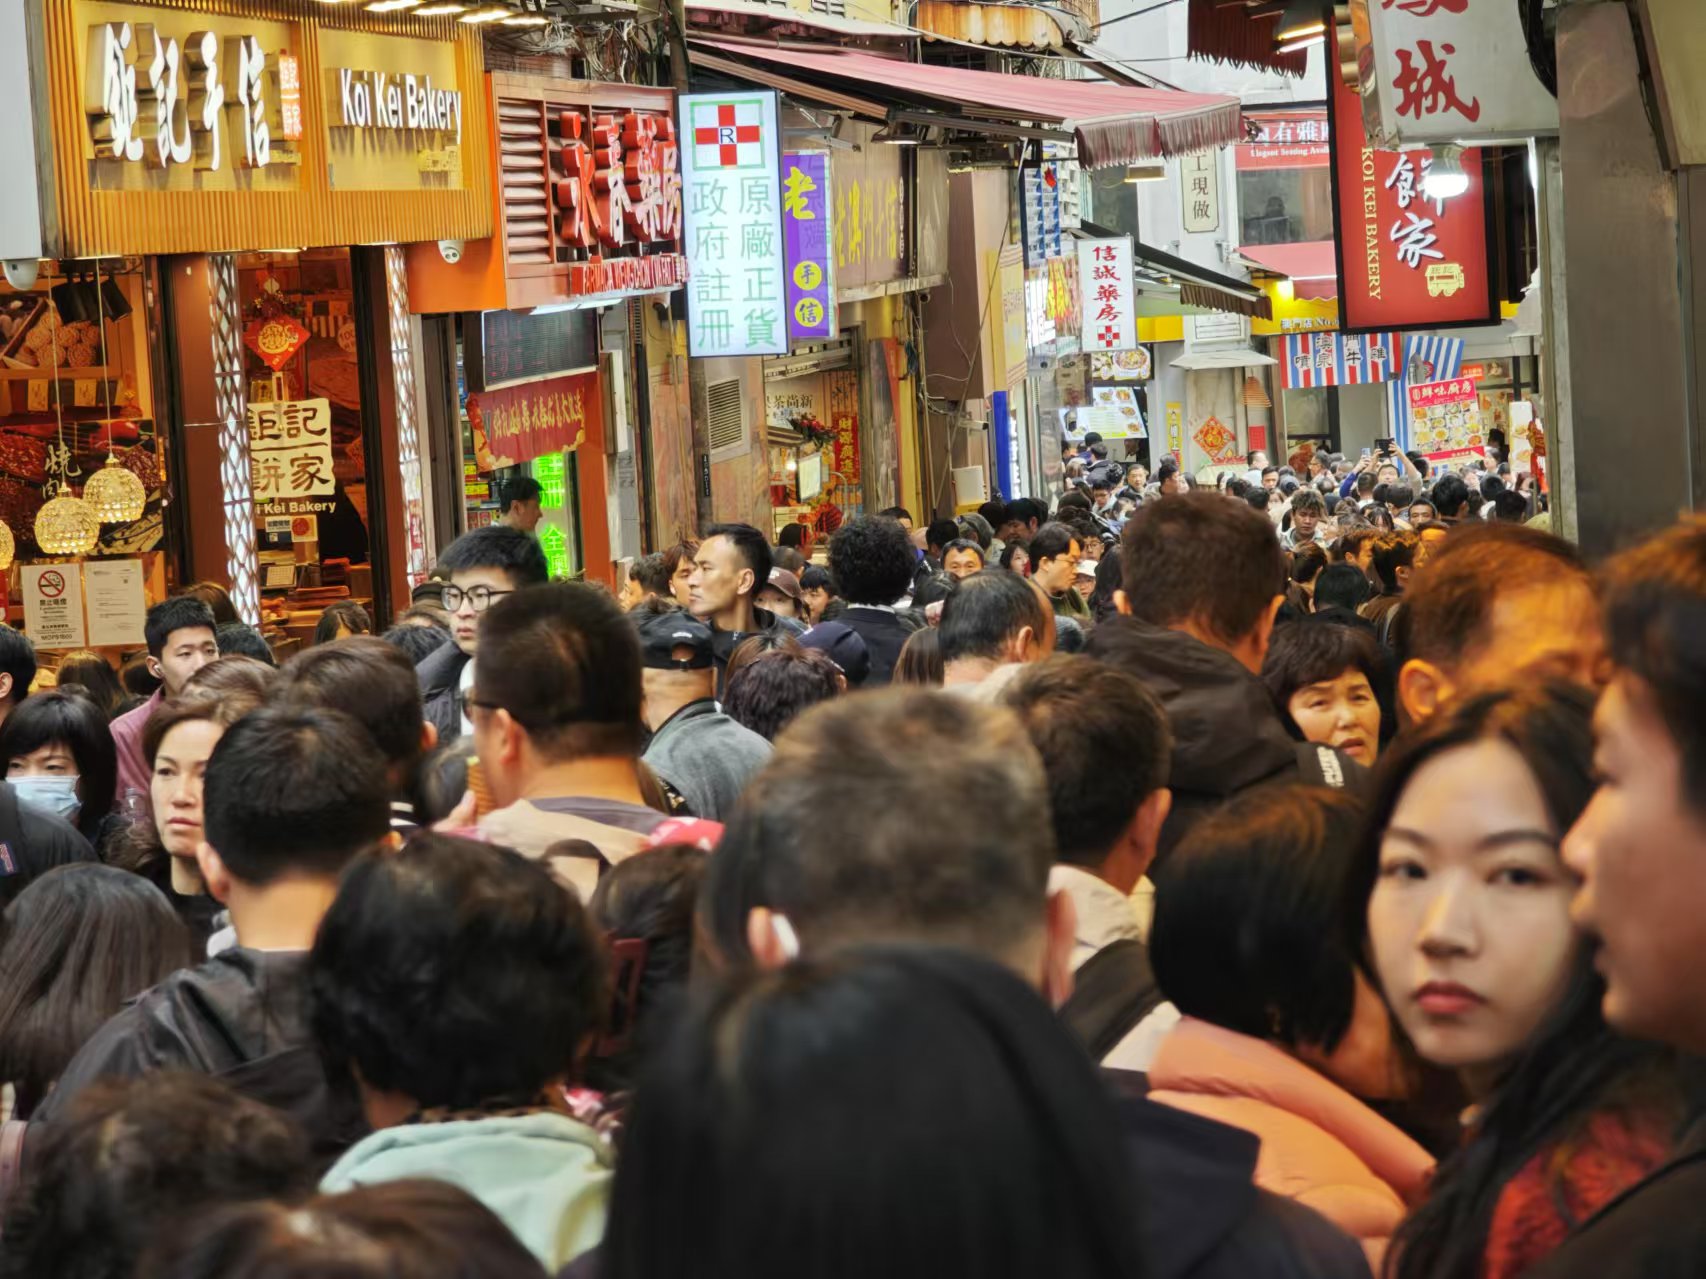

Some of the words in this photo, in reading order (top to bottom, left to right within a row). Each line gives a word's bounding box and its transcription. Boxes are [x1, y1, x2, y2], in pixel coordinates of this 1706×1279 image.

[1381, 0, 1479, 122] 城
[341, 67, 372, 127] Koi
[375, 71, 403, 128] Kei
[405, 73, 462, 144] Bakery
[720, 127, 736, 144] R
[1361, 148, 1375, 182] KOI
[1364, 186, 1377, 219] KEI
[690, 177, 735, 350] 政府註冊
[739, 175, 779, 349] 原廠正貨
[1366, 223, 1381, 300] BAKERY
[264, 503, 286, 515] Kei
[289, 501, 336, 516] Bakery
